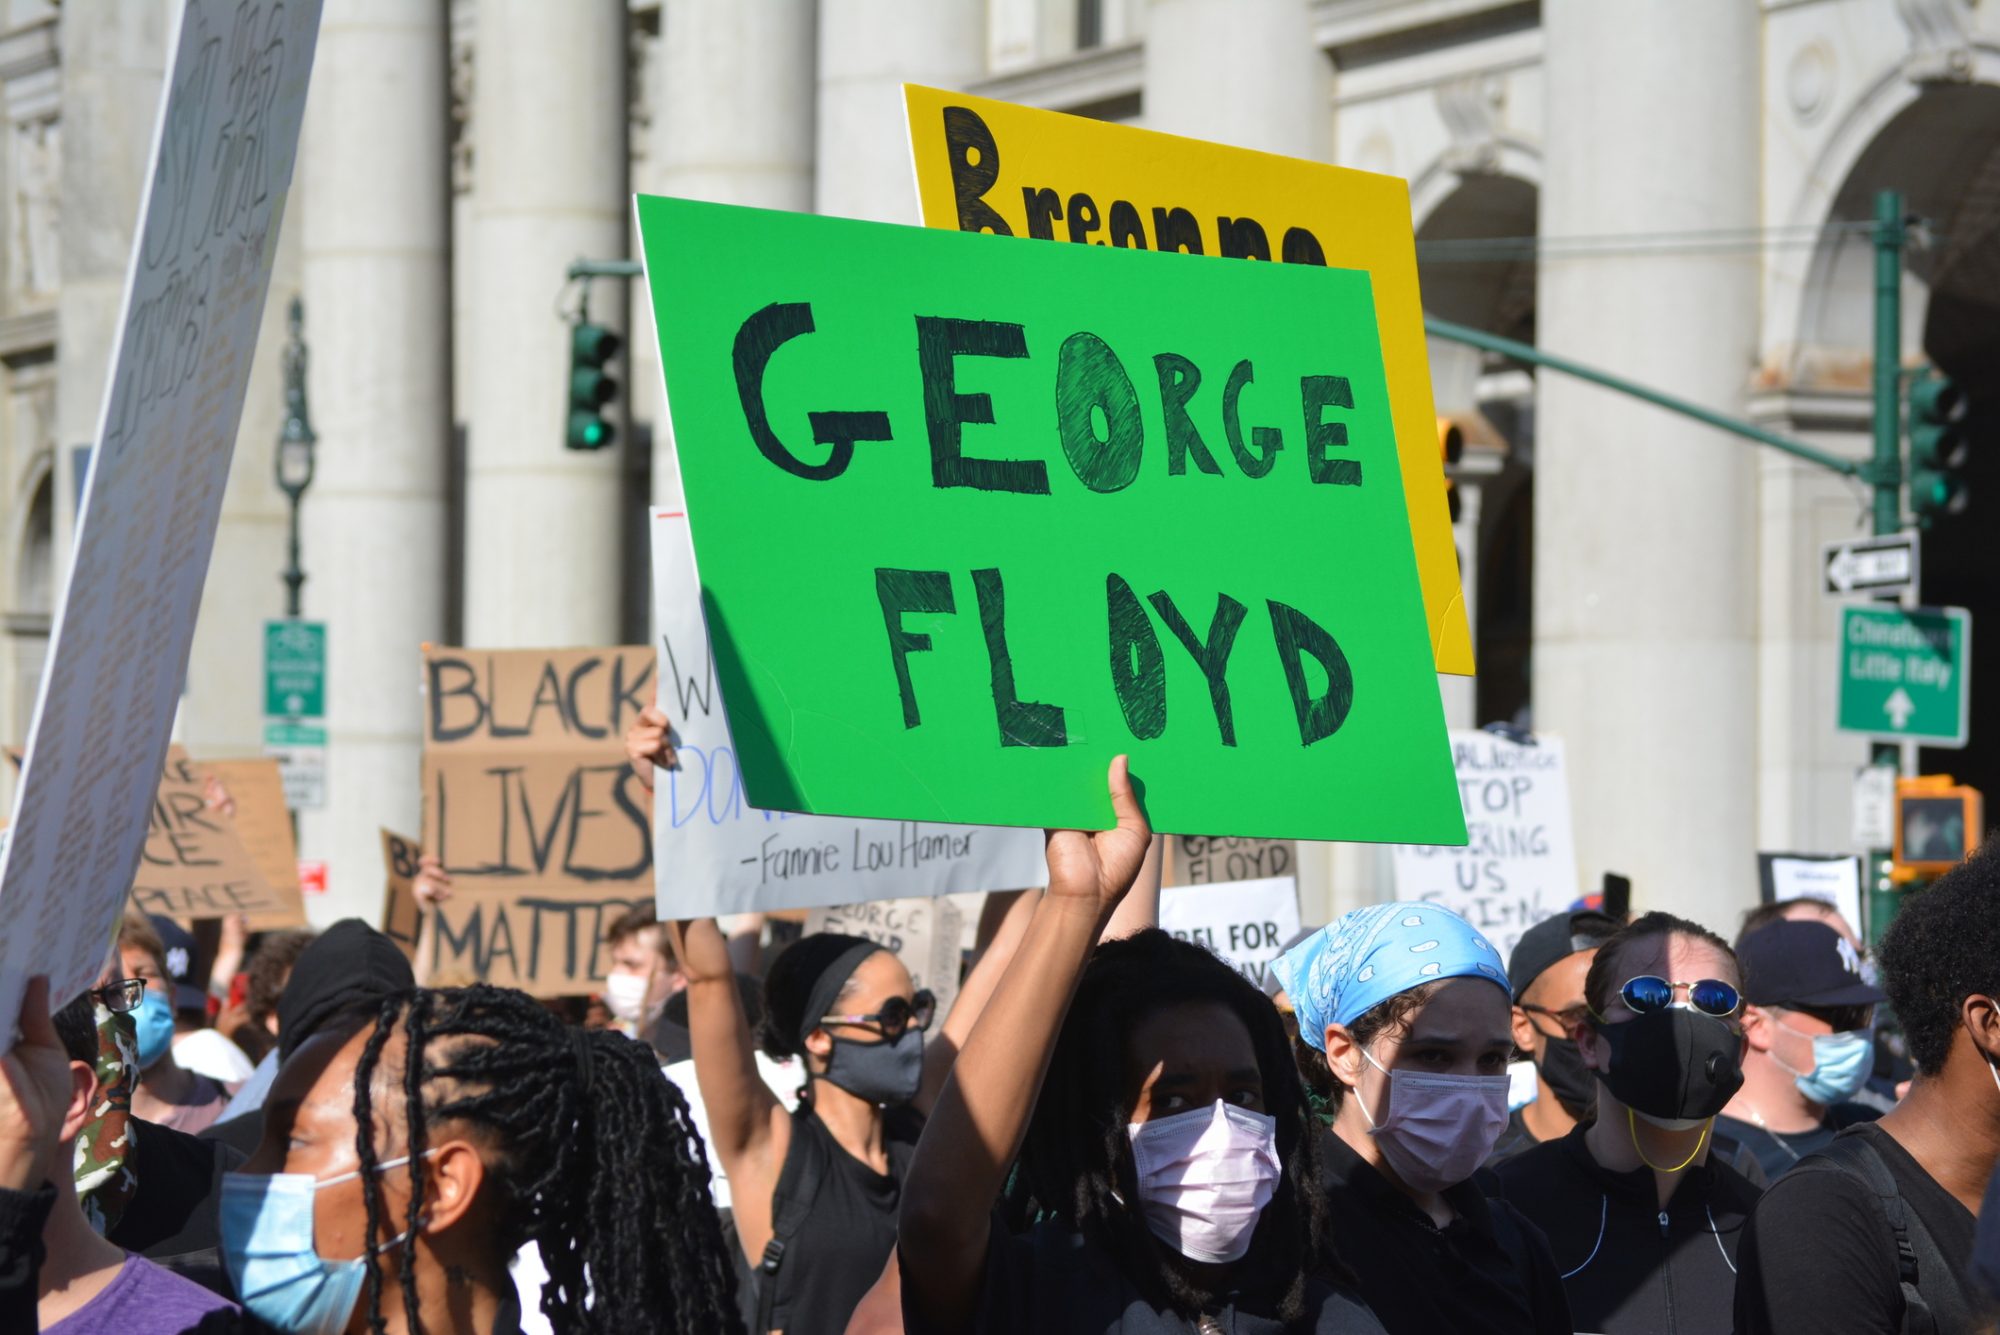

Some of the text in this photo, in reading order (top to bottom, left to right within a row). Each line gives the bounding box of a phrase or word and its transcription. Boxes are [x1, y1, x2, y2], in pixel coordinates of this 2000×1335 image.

[732, 301, 1363, 494] GEORGE
[874, 567, 1354, 748] FLOYD
[1850, 651, 1953, 692] Little Italy
[427, 653, 655, 742] BLACK
[437, 762, 653, 881] LIVES
[1458, 771, 1533, 818] TOP
[852, 827, 894, 872] Lou
[900, 821, 978, 869] Hamer
[1455, 860, 1507, 893] US
[433, 896, 655, 986] MATTE
[1227, 920, 1281, 952] FOR
